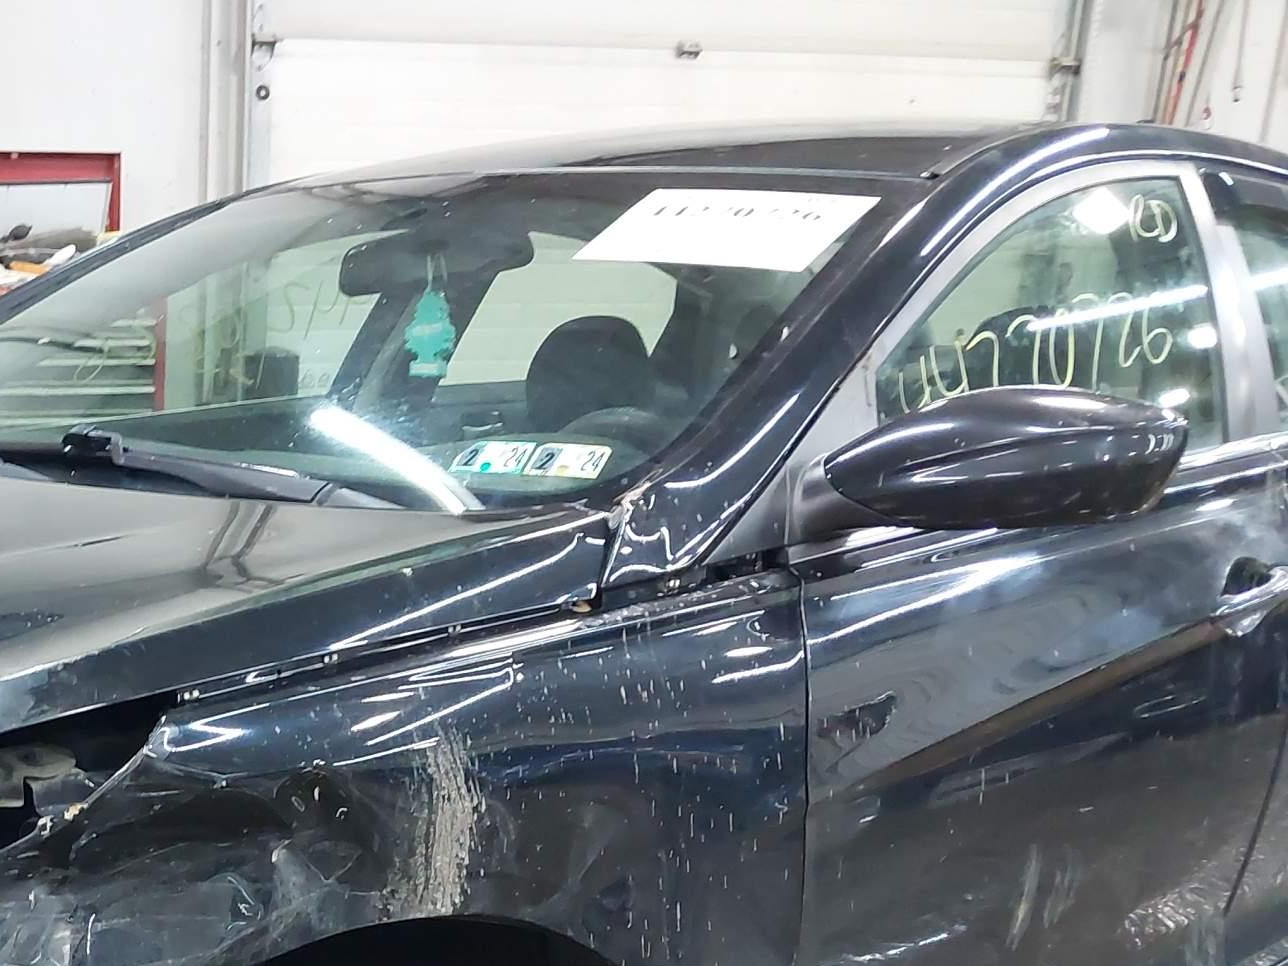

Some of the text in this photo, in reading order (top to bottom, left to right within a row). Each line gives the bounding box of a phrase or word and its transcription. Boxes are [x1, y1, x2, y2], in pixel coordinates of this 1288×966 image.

[461, 446, 528, 468] 2 24
[535, 450, 606, 471] 2 24
